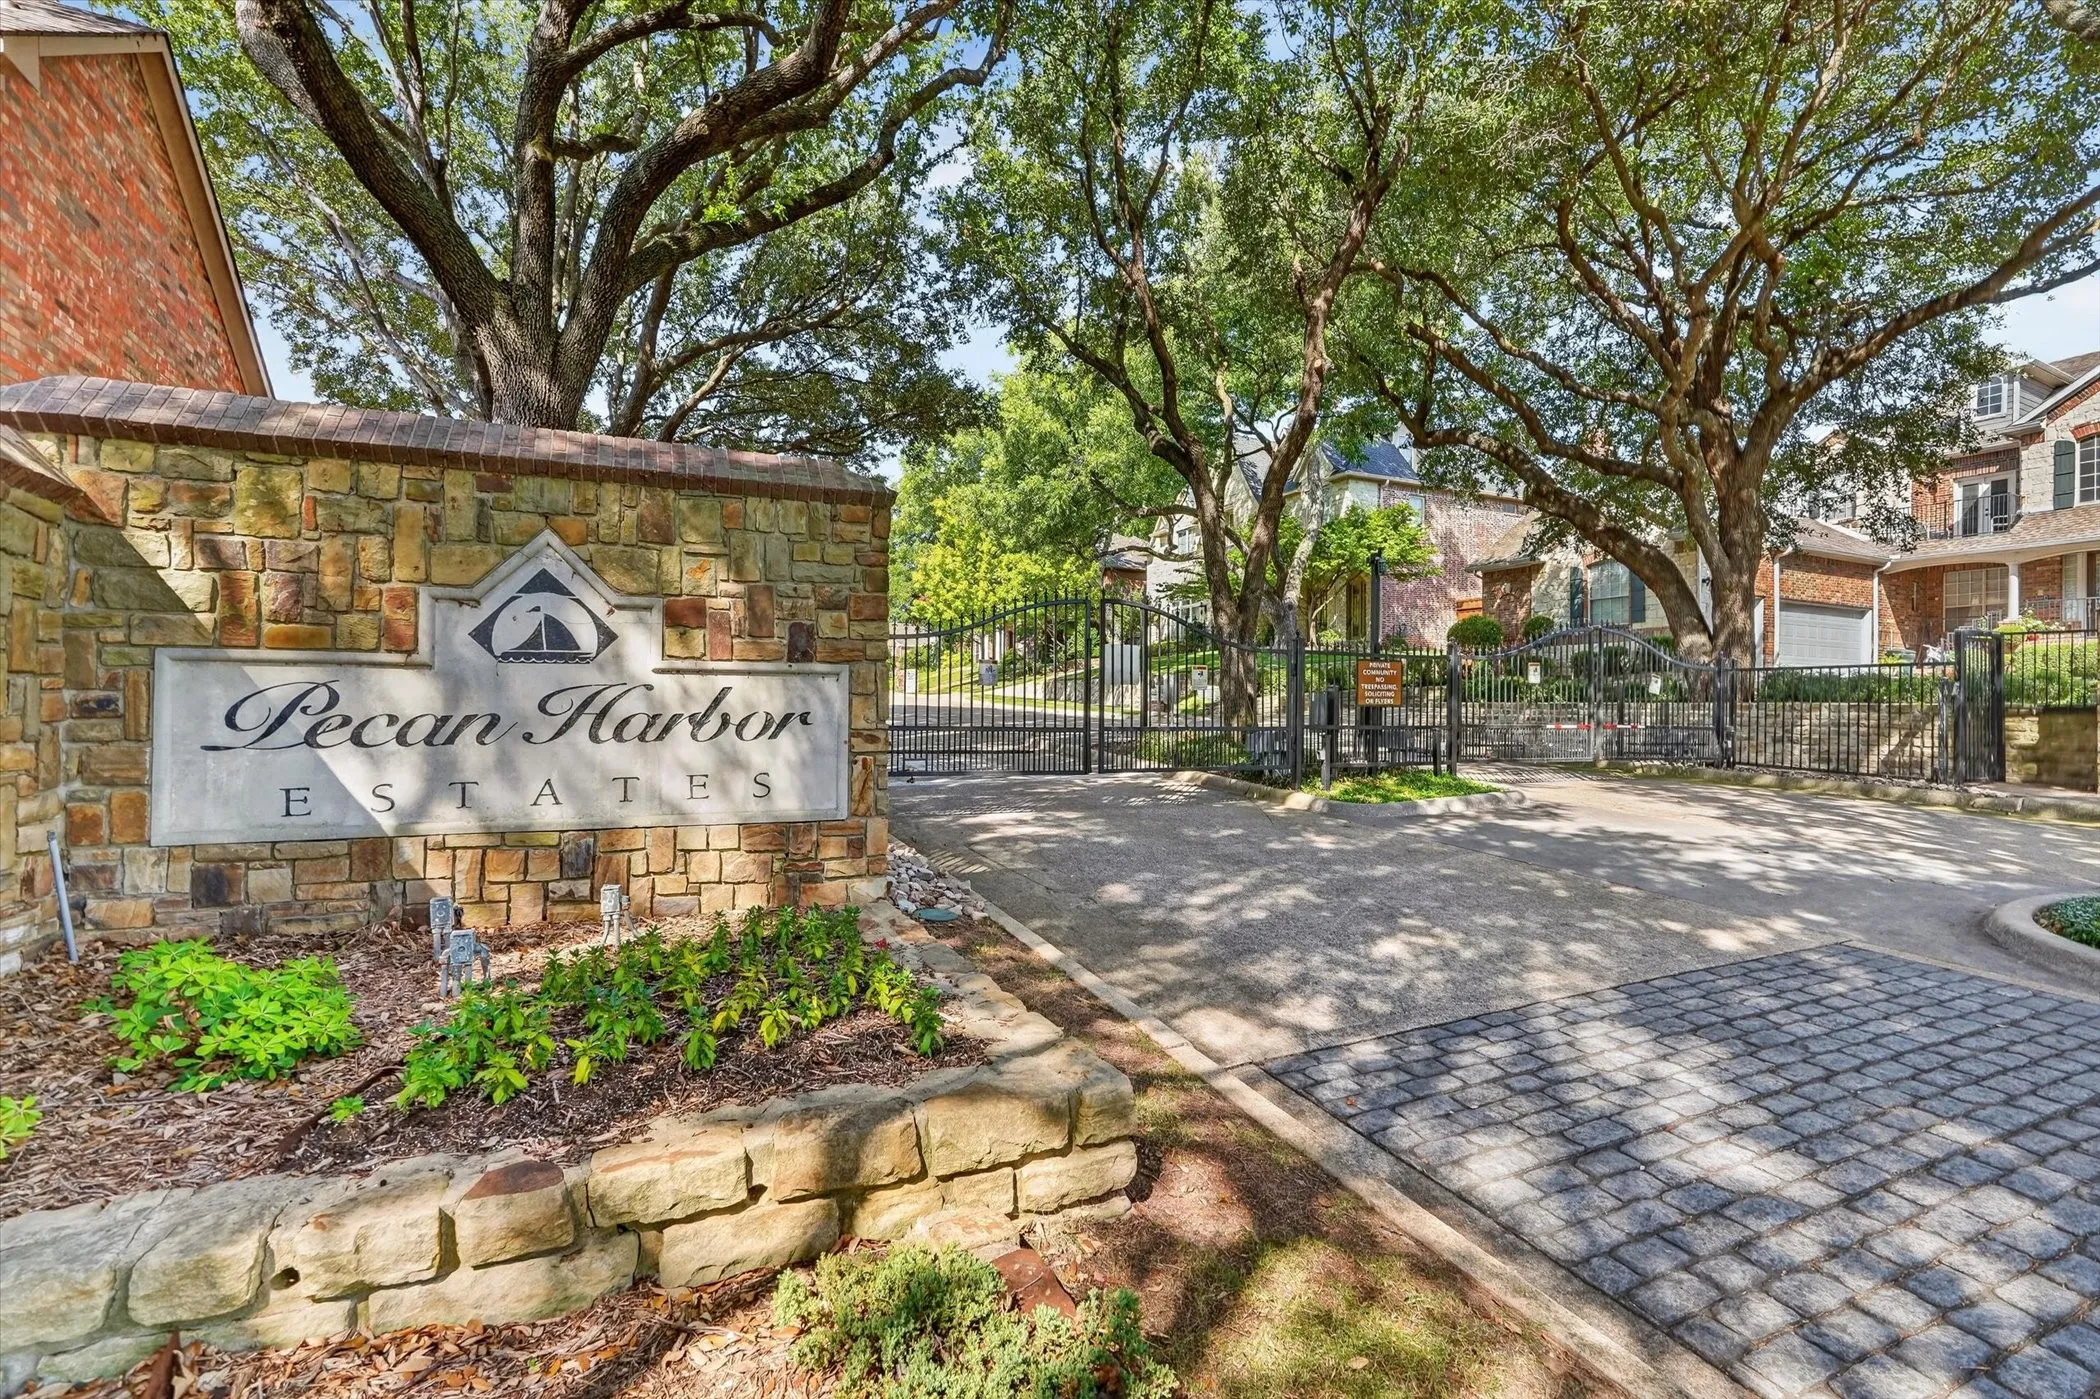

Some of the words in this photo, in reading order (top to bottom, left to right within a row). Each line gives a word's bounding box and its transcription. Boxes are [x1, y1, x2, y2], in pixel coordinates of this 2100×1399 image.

[200, 680, 518, 751] Pecan
[522, 682, 813, 745] Harbor
[279, 772, 774, 818] ESTATES
